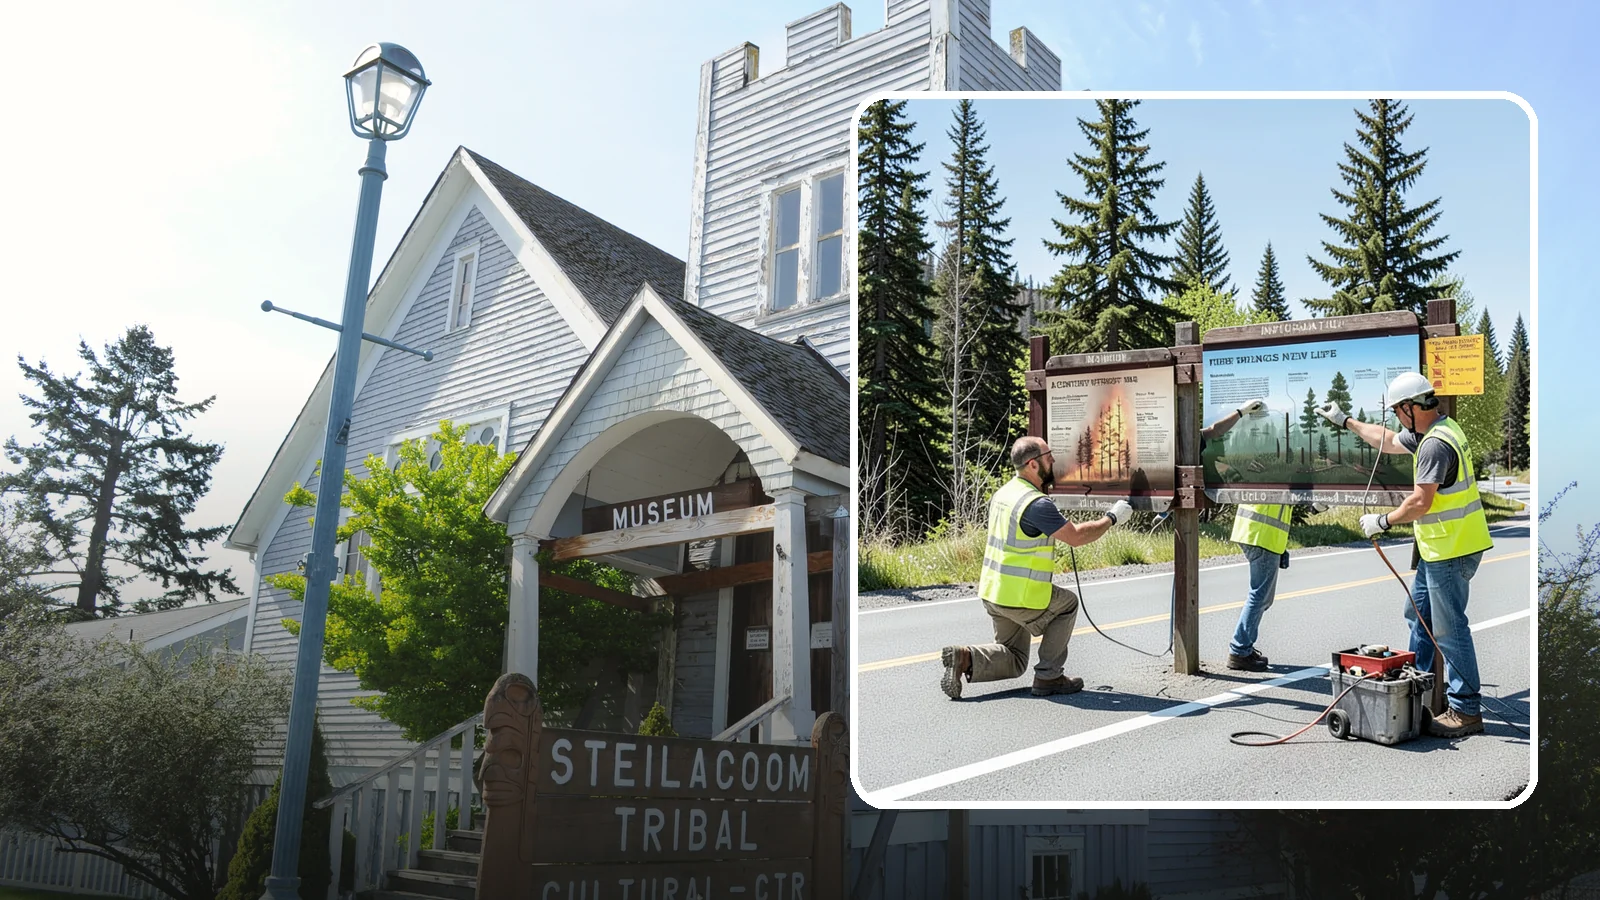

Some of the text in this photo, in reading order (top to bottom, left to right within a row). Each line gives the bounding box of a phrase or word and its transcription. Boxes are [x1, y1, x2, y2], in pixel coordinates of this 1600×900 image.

[612, 491, 714, 531] MUSEUM
[550, 738, 810, 793] STEILACOOM
[614, 806, 758, 852] TRIBAL
